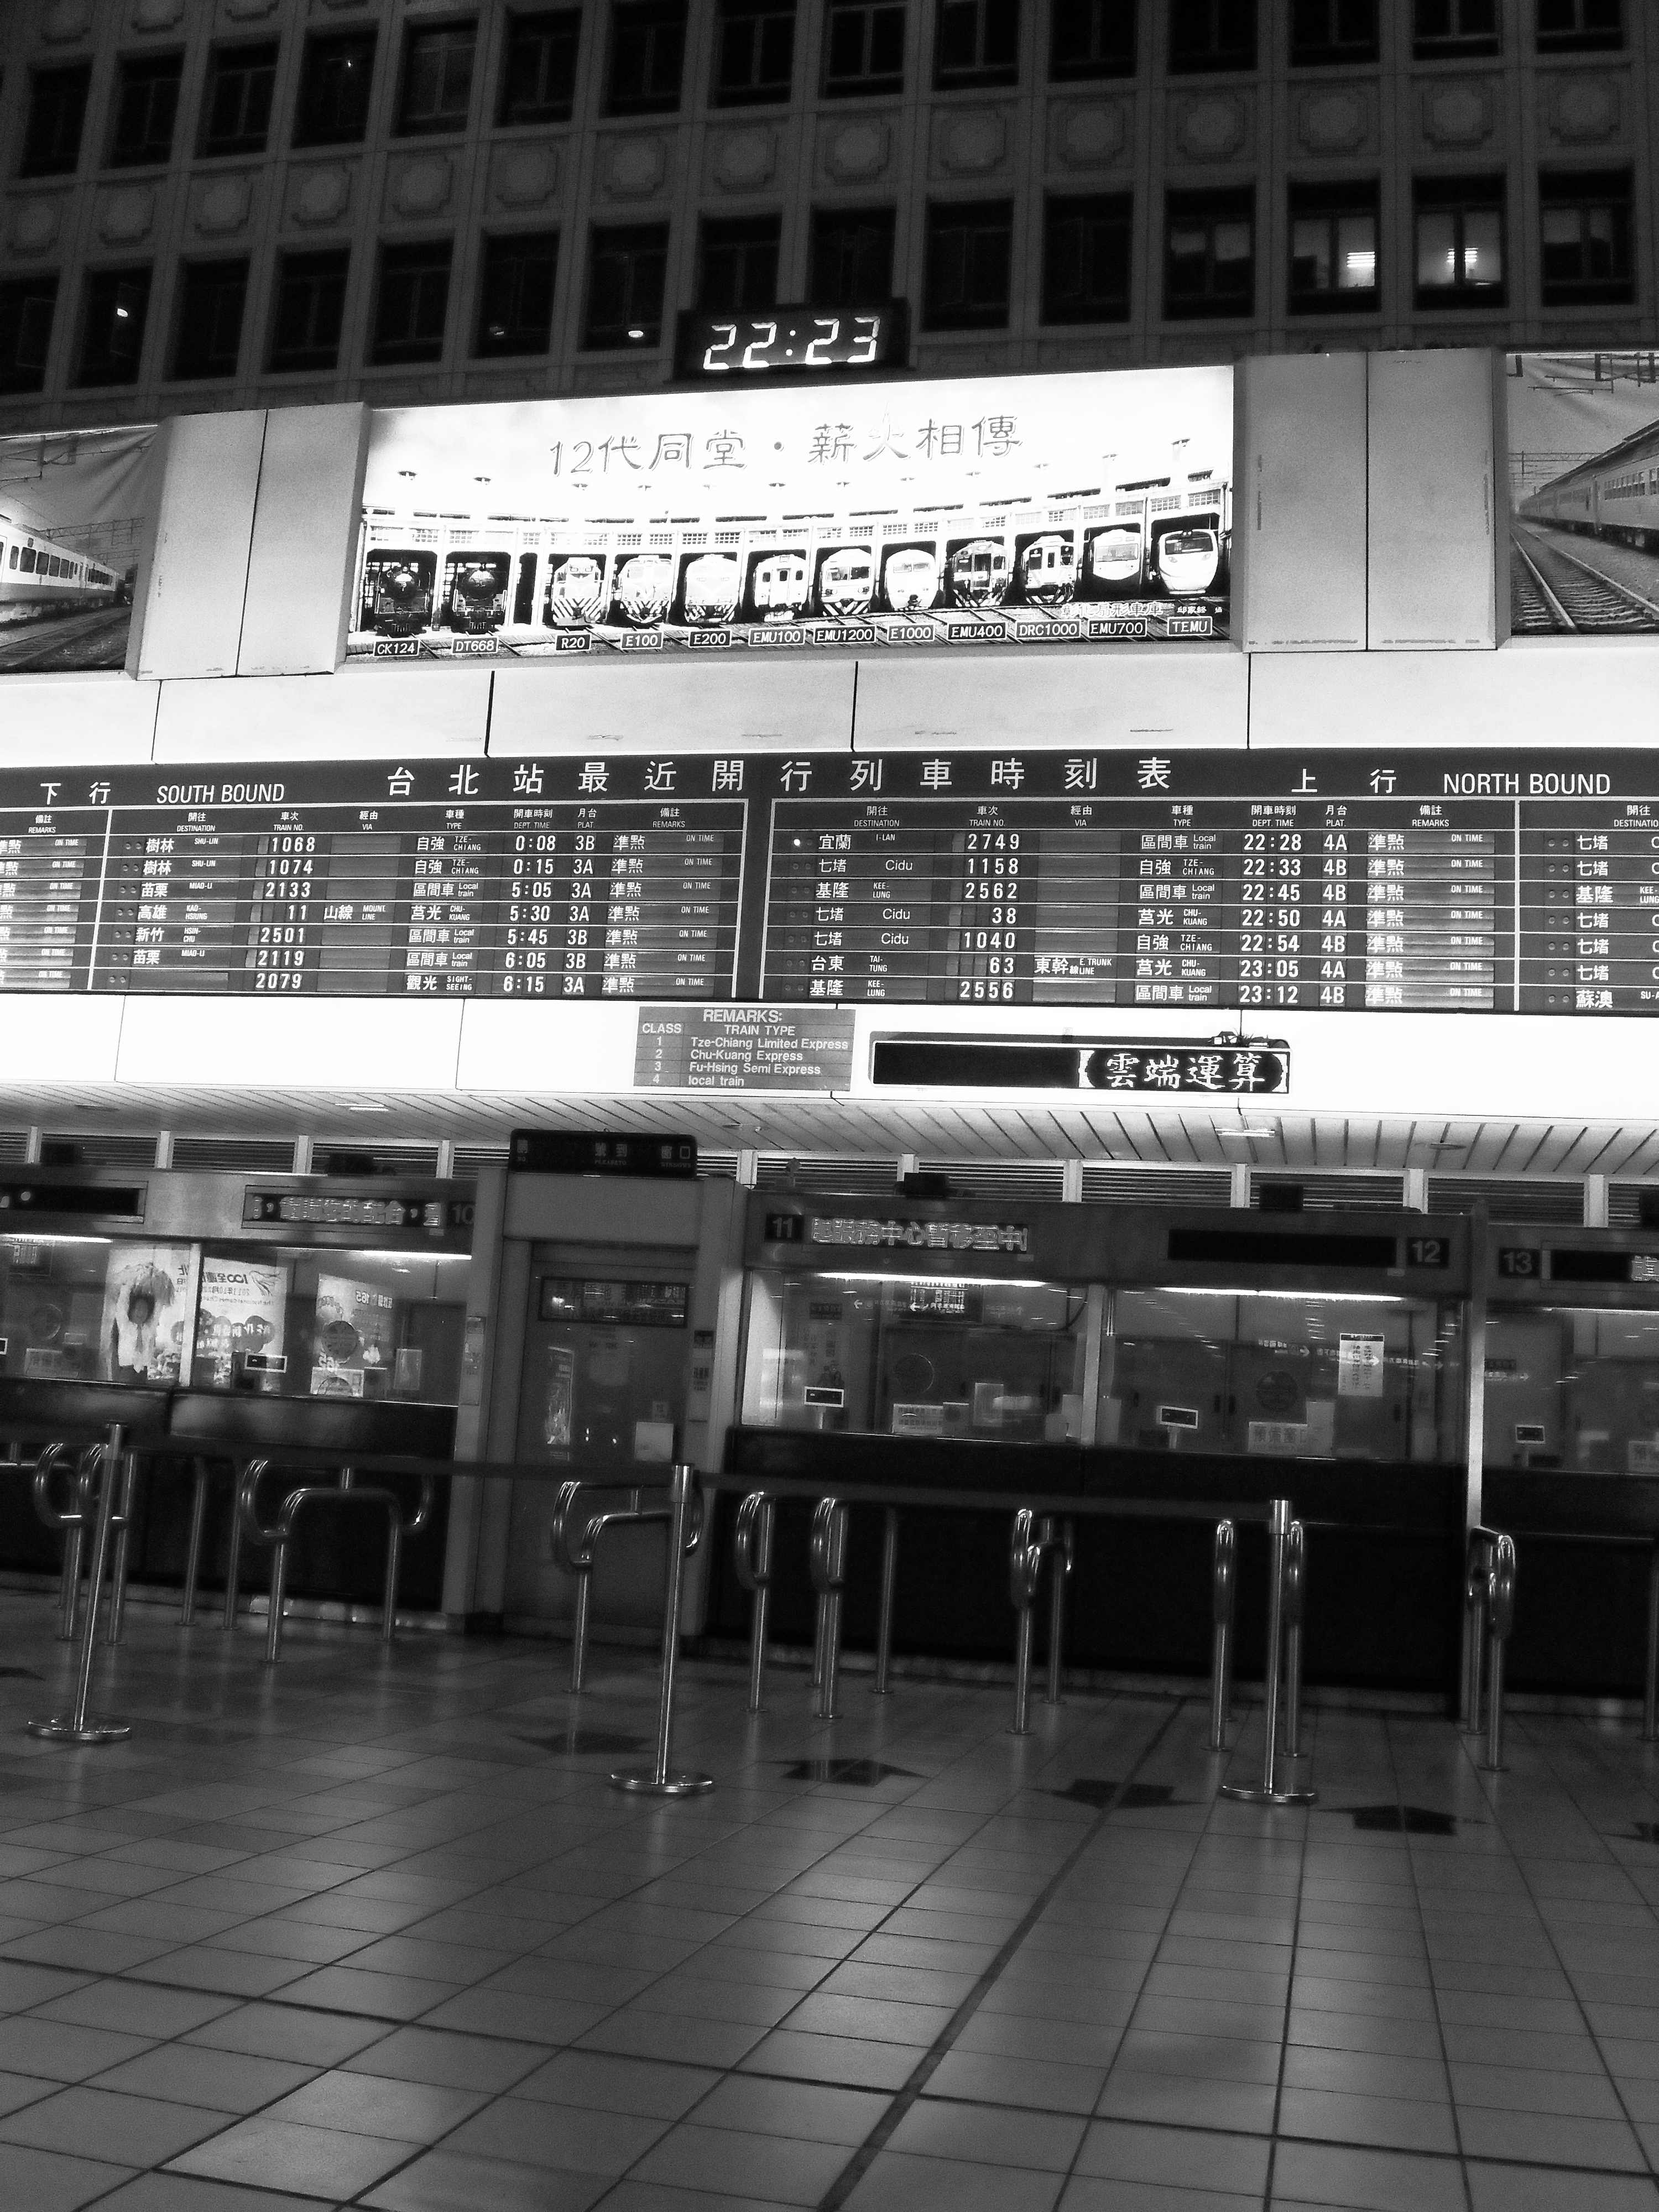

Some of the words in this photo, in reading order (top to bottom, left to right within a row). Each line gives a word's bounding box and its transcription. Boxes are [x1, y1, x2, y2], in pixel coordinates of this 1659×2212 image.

[702, 316, 880, 371] 22:23
[816, 628, 873, 641] EMU1200
[890, 627, 932, 639] E1000
[951, 624, 1003, 638] EMU400
[1019, 623, 1077, 637] DRC1000
[1090, 622, 1144, 634] EMU700
[1172, 620, 1208, 633] TEMU
[561, 637, 585, 649] R20
[625, 634, 659, 646] E100
[693, 632, 727, 645] E200
[753, 631, 801, 643] EMU100
[377, 642, 415, 655] CK124
[455, 640, 494, 652] DT668
[1444, 773, 1519, 794] NORTH
[1530, 773, 1610, 795] BOUND
[156, 785, 215, 804] SOUTH
[221, 784, 285, 802] BOUND
[187, 812, 206, 822] 開往
[280, 811, 299, 821] 車次
[359, 810, 378, 820] 經由
[445, 809, 465, 819] 車種
[513, 808, 553, 818] 開車時刻
[577, 808, 597, 818] 月台
[660, 807, 680, 817] 備註
[867, 806, 888, 816] 開往
[977, 805, 998, 816] 車次
[1071, 805, 1092, 815] 經由
[1171, 805, 1193, 815] 車種
[1251, 805, 1296, 816] 開車時刻
[1325, 805, 1347, 816] 月台
[1420, 805, 1442, 816] 備註
[1627, 805, 1651, 816] 開往
[35, 815, 52, 824] 備註
[1173, 818, 1191, 827] TYPE
[1614, 819, 1658, 827] DESTINATIO
[272, 837, 315, 852] 1068
[515, 835, 556, 851] 0:08
[575, 835, 595, 851] 3B
[818, 833, 852, 850] 宜蘭
[967, 833, 1019, 849] 2749
[1141, 834, 1188, 850] 區間車
[1244, 833, 1301, 851] 22:28
[1323, 834, 1347, 851] 4A
[1368, 834, 1405, 852] 準點
[1451, 834, 1462, 842] ON
[1465, 834, 1483, 842] TIME
[270, 859, 313, 875] 1074
[513, 858, 554, 874] 0:15
[573, 859, 593, 874] 3A
[818, 858, 847, 873] 七堵
[885, 859, 913, 870] Cidu
[968, 858, 1019, 874] 1158
[1140, 859, 1171, 875] 自強
[1243, 858, 1301, 876] 22:33
[1323, 859, 1347, 876] 4B
[141, 882, 169, 898] 苗栗
[265, 881, 311, 898] 2133
[512, 881, 551, 898] 5:05
[571, 882, 591, 898] 3A
[816, 881, 849, 899] 基隆
[965, 882, 1017, 899] 2562
[1243, 884, 1300, 901] 22:45
[1323, 884, 1346, 901] 4B
[138, 904, 168, 920] 高雄
[289, 905, 306, 920] 11
[510, 905, 550, 921] 5:30
[569, 905, 589, 921] 3A
[883, 908, 910, 920] Cidu
[992, 907, 1016, 924] 38
[1138, 908, 1174, 926] 莒光
[1242, 909, 1300, 927] 22:50
[1322, 910, 1346, 927] 4A
[135, 927, 165, 942] 新竹
[260, 927, 304, 943] 2501
[507, 928, 547, 945] 5:45
[567, 929, 587, 945] 3B
[881, 932, 909, 945] Cidu
[964, 932, 1015, 949] 1040
[1241, 934, 1300, 952] 22:54
[1322, 935, 1345, 952] 4B
[257, 950, 305, 966] 2119
[505, 952, 546, 968] 6:05
[566, 953, 586, 969] 3B
[811, 954, 844, 972] 台東
[990, 957, 1014, 974] 63
[1240, 959, 1298, 978] 23:05
[1321, 961, 1345, 978] 4A
[255, 973, 302, 989] 2079
[503, 975, 544, 993] 6:15
[564, 976, 584, 993] 3A
[960, 980, 1013, 999] 2556
[1239, 985, 1298, 1004] 23:12
[1321, 986, 1344, 1004] 4B
[1575, 989, 1613, 1008] 蘇澳
[703, 1009, 782, 1022] REMARKS:
[642, 1024, 681, 1034] CLASS
[724, 1025, 759, 1035] TRAIN
[765, 1026, 795, 1036] TYPE
[656, 1037, 662, 1046] 1
[691, 1037, 753, 1048] Tze-Chiang
[758, 1038, 798, 1048] Limited
[801, 1039, 848, 1051] Express
[655, 1050, 662, 1059] 2
[690, 1050, 752, 1062] Chu-Kuang
[757, 1051, 803, 1062] Express
[654, 1062, 661, 1072] 3
[689, 1063, 738, 1075] Fu-Hsing
[743, 1063, 771, 1074] Semi
[774, 1064, 821, 1076] Express
[653, 1074, 660, 1084] 4
[688, 1076, 714, 1086] local
[720, 1076, 745, 1087] train
[452, 1204, 475, 1224] 10
[773, 1217, 793, 1238] 11
[1411, 1239, 1441, 1263] 12
[1503, 1251, 1532, 1274] 13
